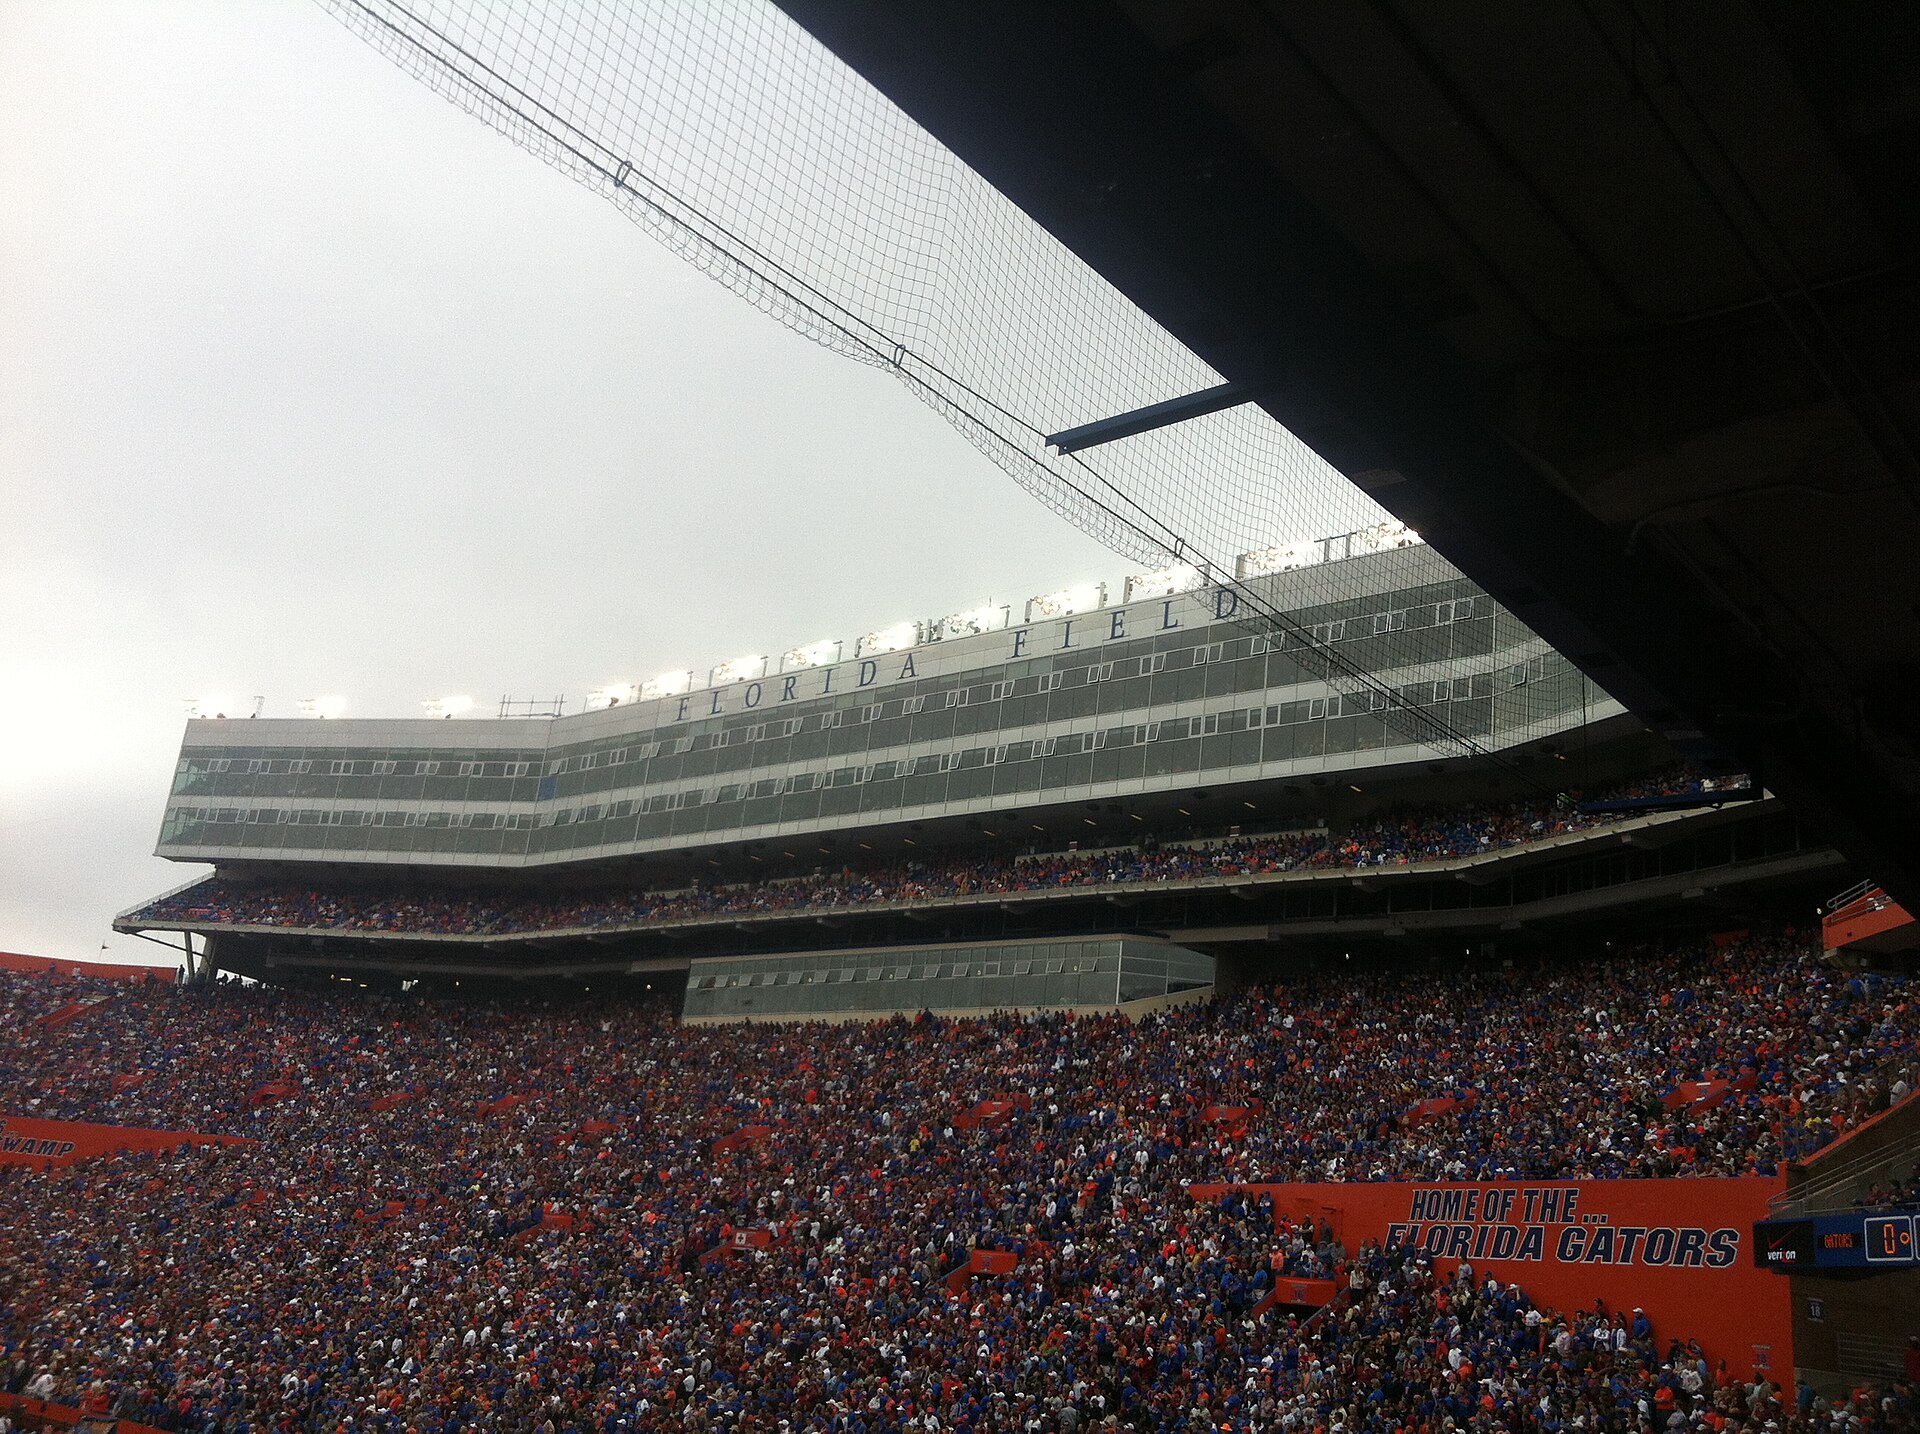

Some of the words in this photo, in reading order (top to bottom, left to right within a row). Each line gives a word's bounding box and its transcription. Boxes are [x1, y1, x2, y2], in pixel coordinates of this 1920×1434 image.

[674, 651, 920, 722] FLORIDA
[1010, 587, 1239, 660] FIELD
[0, 1136, 76, 1158] WAMP
[1408, 1188, 1480, 1222] HOME
[1481, 1188, 1517, 1222] OF
[1556, 1226, 1741, 1268] GATORS
